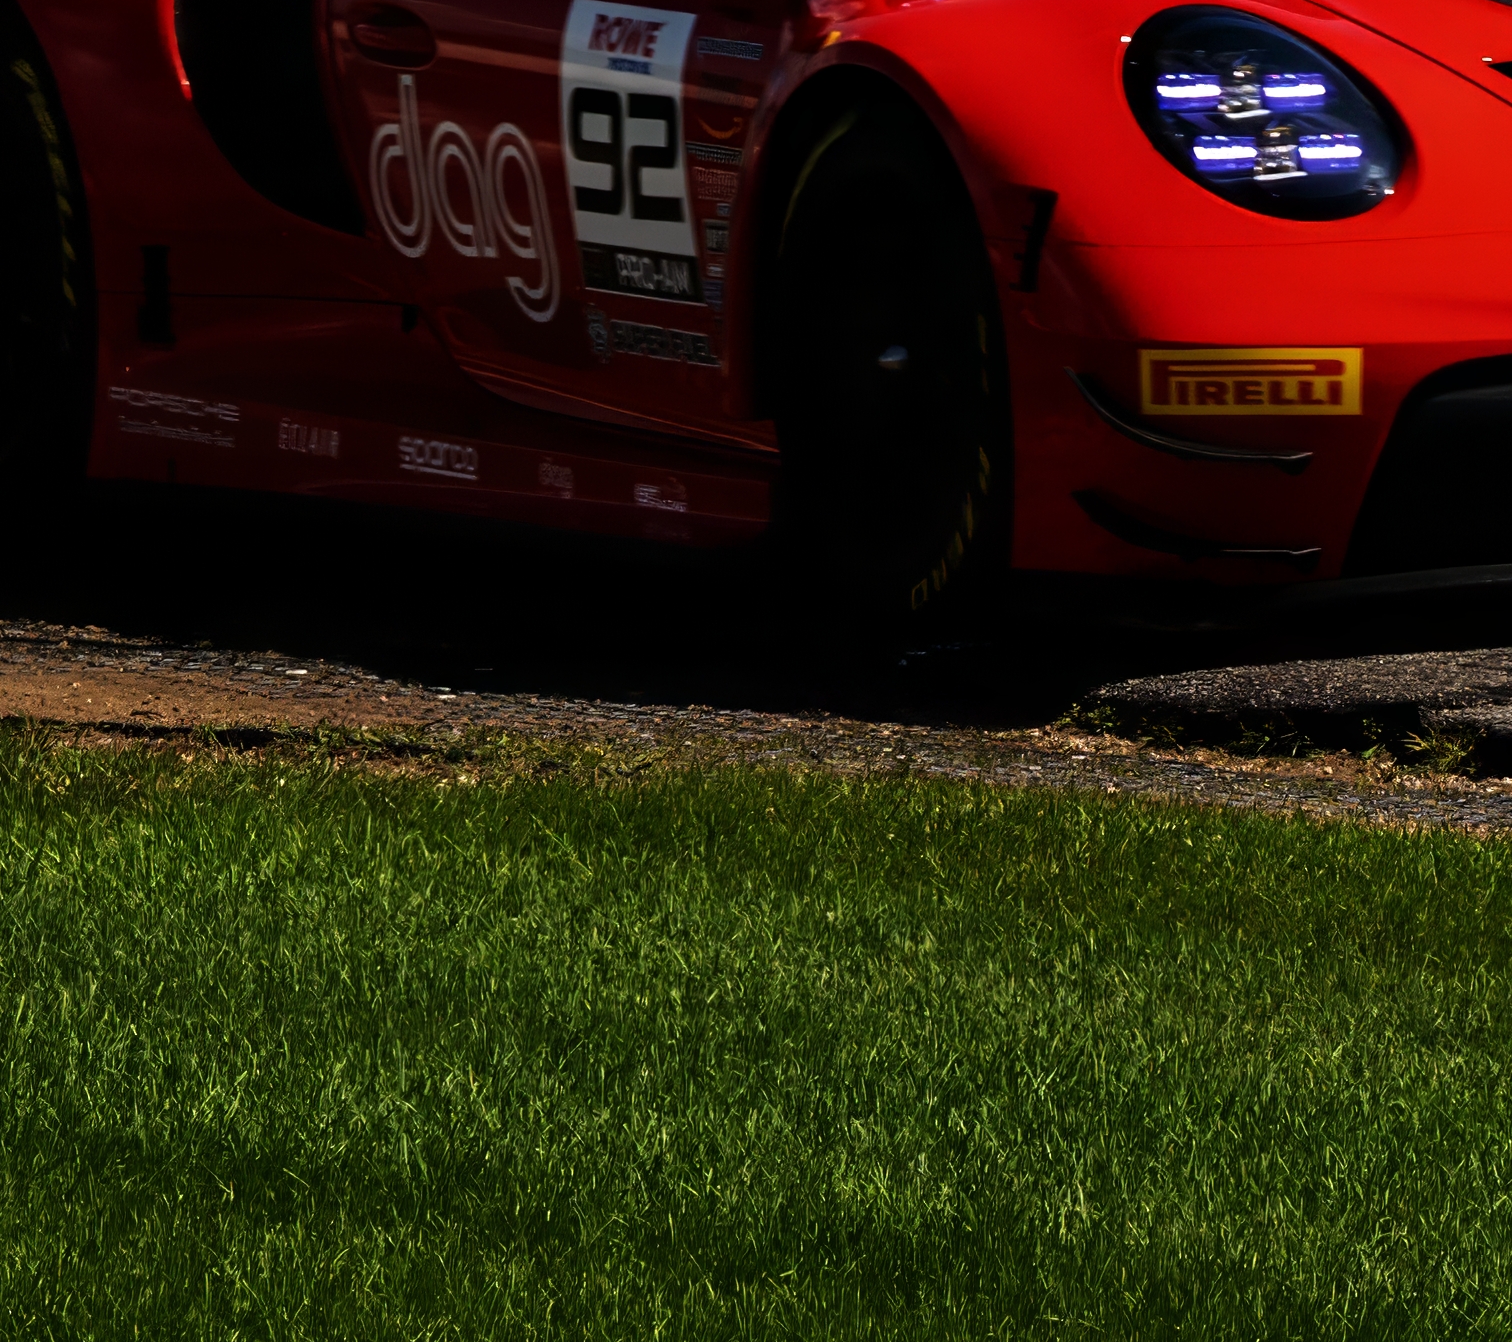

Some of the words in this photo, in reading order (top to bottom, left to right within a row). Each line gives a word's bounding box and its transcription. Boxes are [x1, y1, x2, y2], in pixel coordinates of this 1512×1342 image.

[587, 13, 666, 59] ROWE
[370, 73, 562, 323] dag
[572, 86, 685, 222] 92
[1152, 358, 1345, 408] PIRELLI
